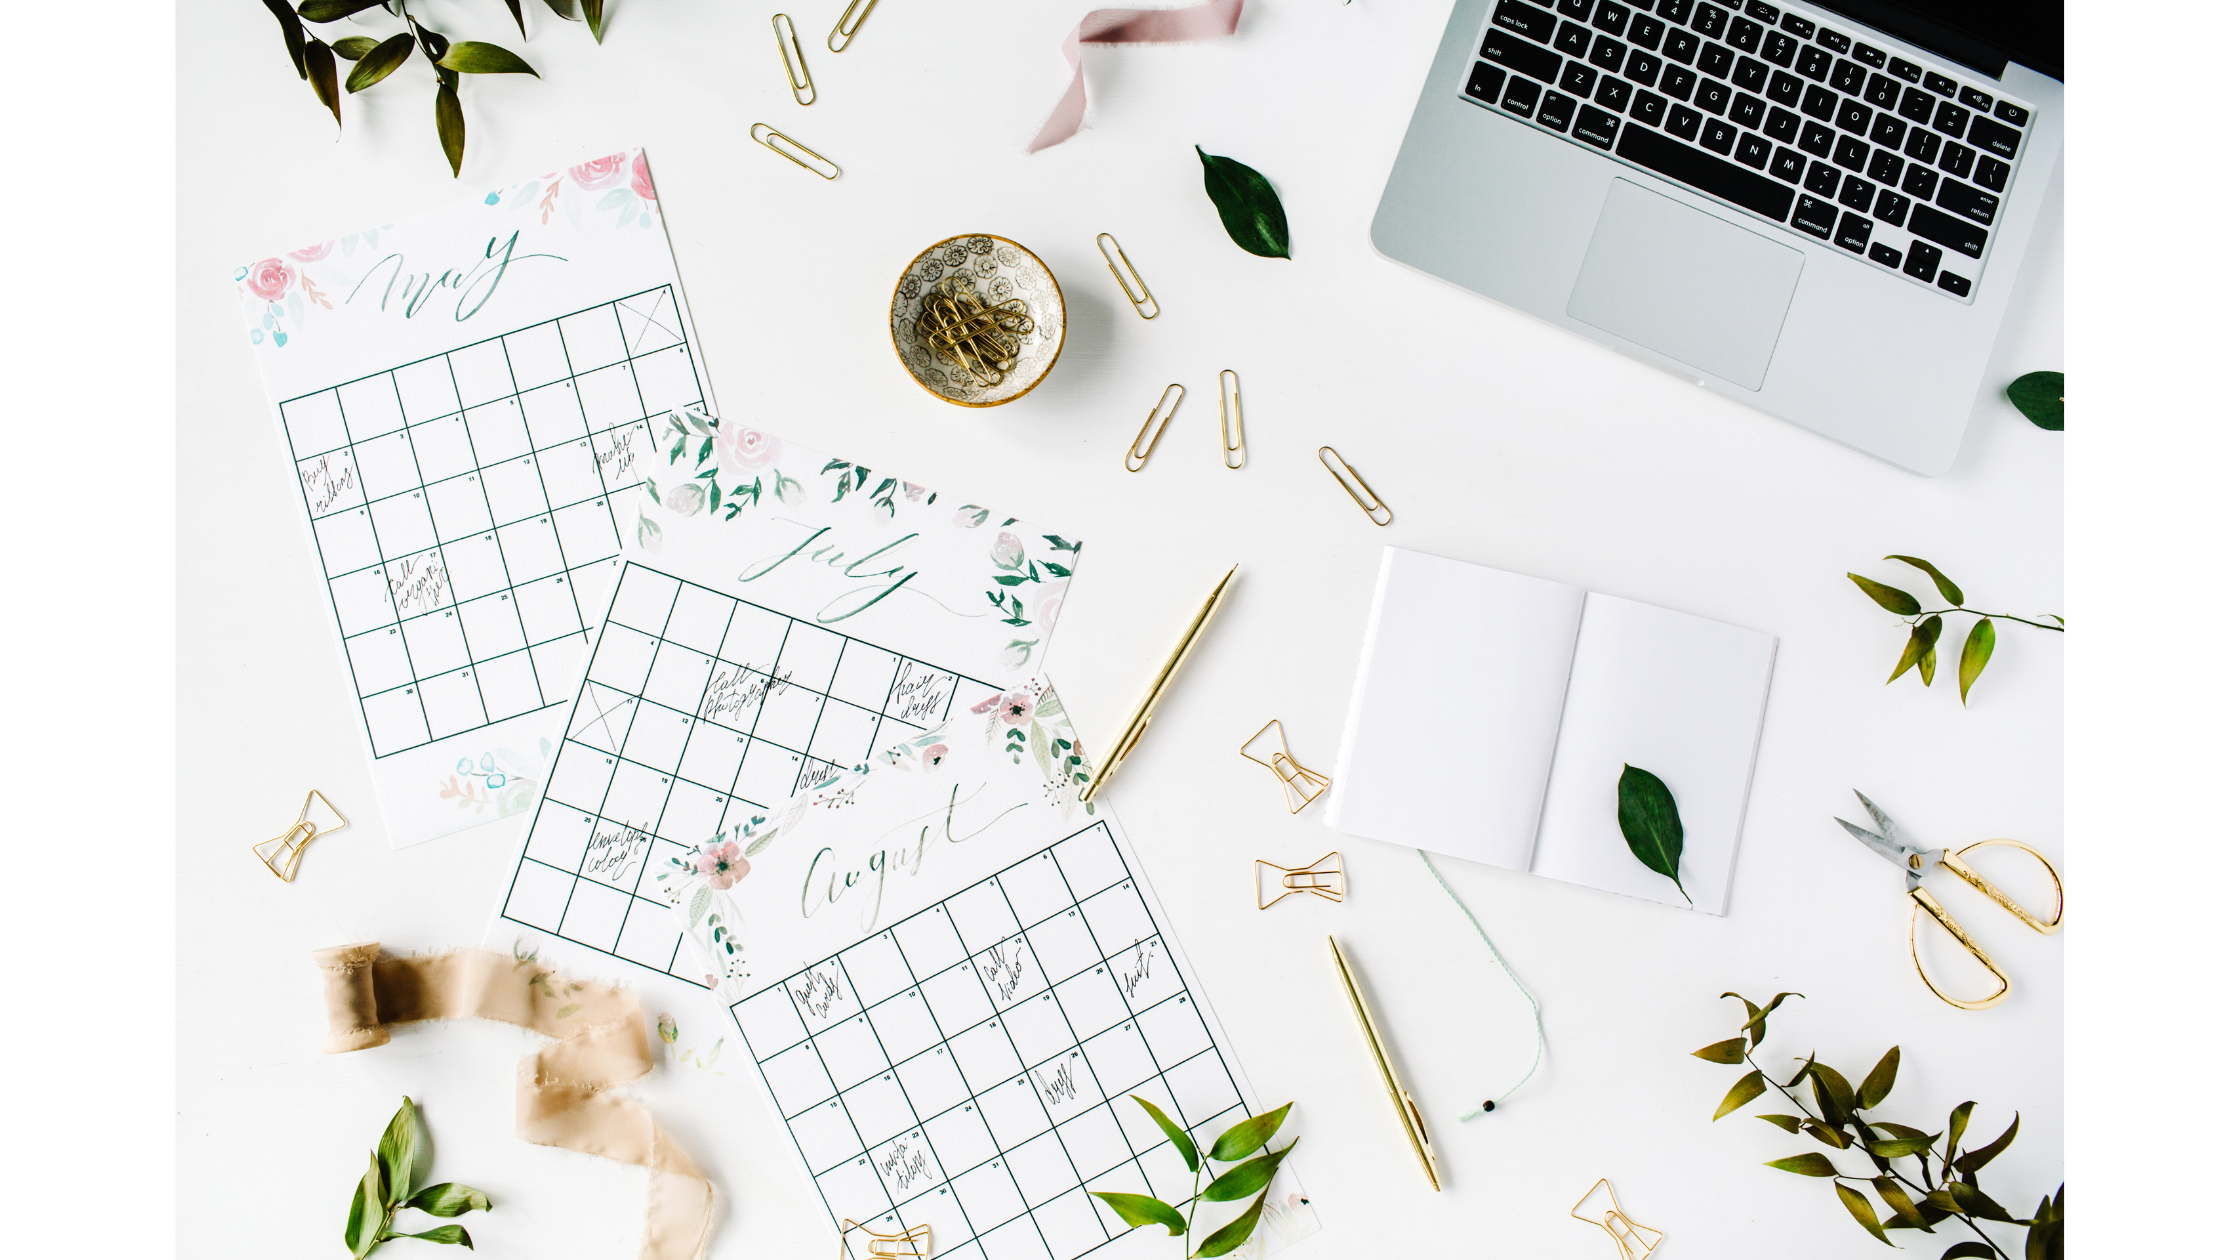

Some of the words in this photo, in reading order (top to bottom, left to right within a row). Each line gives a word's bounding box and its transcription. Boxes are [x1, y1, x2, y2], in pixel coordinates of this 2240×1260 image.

[1572, 0, 1583, 8] Q
[1607, 10, 1619, 22] W
[1670, 7, 1678, 15] 4
[1499, 15, 1515, 25] caps
[1515, 19, 1528, 30] lock
[1705, 20, 1713, 29] 5
[1643, 25, 1651, 36] E
[1568, 34, 1577, 44] A
[1740, 35, 1747, 44] 6
[1678, 40, 1686, 50] R
[1487, 47, 1502, 57] shift
[1605, 48, 1613, 58] S
[1775, 48, 1783, 57] 7
[1714, 54, 1721, 64] T
[1639, 61, 1649, 72] D
[1809, 63, 1817, 72] 8
[1749, 68, 1757, 78] Y
[1574, 73, 1584, 84] Z
[1675, 76, 1683, 86] F
[1844, 77, 1851, 86] 9
[1474, 84, 1482, 92] fn
[1609, 87, 1619, 98] X
[1782, 82, 1791, 93] U
[1709, 91, 1719, 101] G
[1878, 91, 1886, 101] 0
[1507, 98, 1529, 111] control
[1645, 102, 1654, 112] C
[1744, 104, 1754, 116] H
[1542, 113, 1562, 125] option
[1682, 116, 1690, 126] V
[1851, 111, 1860, 121] O
[1779, 120, 1787, 129] J
[1885, 125, 1894, 134] P
[1578, 127, 1610, 144] command
[1715, 130, 1723, 141] B
[1813, 133, 1823, 144] K
[1749, 144, 1759, 156] N
[1992, 140, 2011, 152] delete
[1849, 147, 1855, 158] L
[1783, 159, 1795, 171] M
[1979, 196, 1994, 205] enter
[1970, 207, 1990, 219] return
[1797, 217, 1828, 234] command
[1844, 236, 1864, 248] option
[1964, 241, 1978, 251] shift
[802, 781, 1028, 934] August
